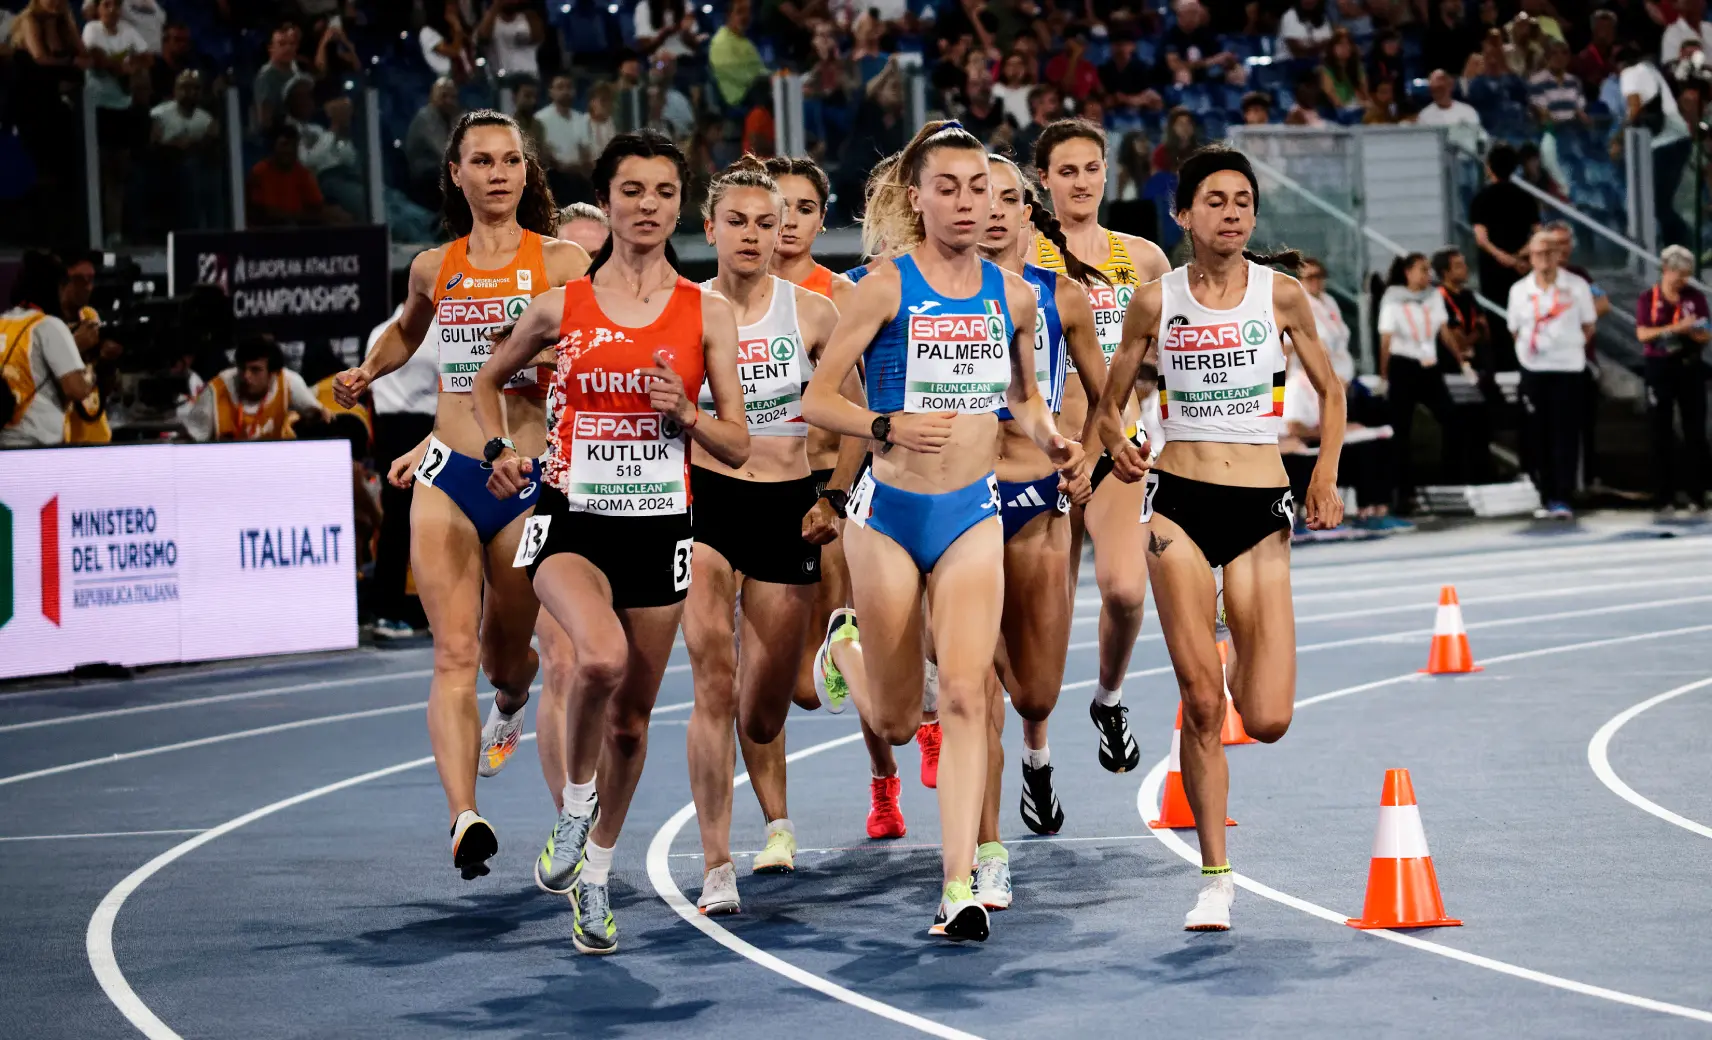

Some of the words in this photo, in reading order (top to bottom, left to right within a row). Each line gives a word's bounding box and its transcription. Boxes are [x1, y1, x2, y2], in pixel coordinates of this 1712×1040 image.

[248, 260, 300, 278] EUROPEAN
[305, 255, 359, 275] ATHLETICS
[233, 284, 360, 319] CHAMPIONSHIPS
[440, 302, 503, 322] SPAR
[914, 319, 985, 338] SPAR
[1165, 326, 1239, 348] SPAR
[917, 343, 1004, 360] PALMERO
[1171, 349, 1257, 370] HERBIET
[460, 362, 480, 372] RUN
[741, 362, 790, 381] LENT
[952, 363, 974, 375] 476
[1202, 372, 1228, 384] 402
[937, 384, 960, 393] RUN
[1189, 393, 1212, 401] RUN
[922, 396, 966, 409] ROMA
[1181, 405, 1223, 418] ROMA
[1227, 400, 1260, 415] 2024
[756, 407, 788, 424] 2024
[577, 417, 657, 437] SPAR
[587, 444, 669, 461] KUTLUK
[616, 465, 642, 477] 518
[600, 484, 625, 494] RUN
[587, 499, 635, 511] ROMA
[638, 497, 674, 510] 2024
[71, 507, 156, 538] MINISTERO
[240, 525, 341, 569] ITALIA.IT
[73, 545, 103, 573] DEL
[108, 540, 177, 570] TURISMO
